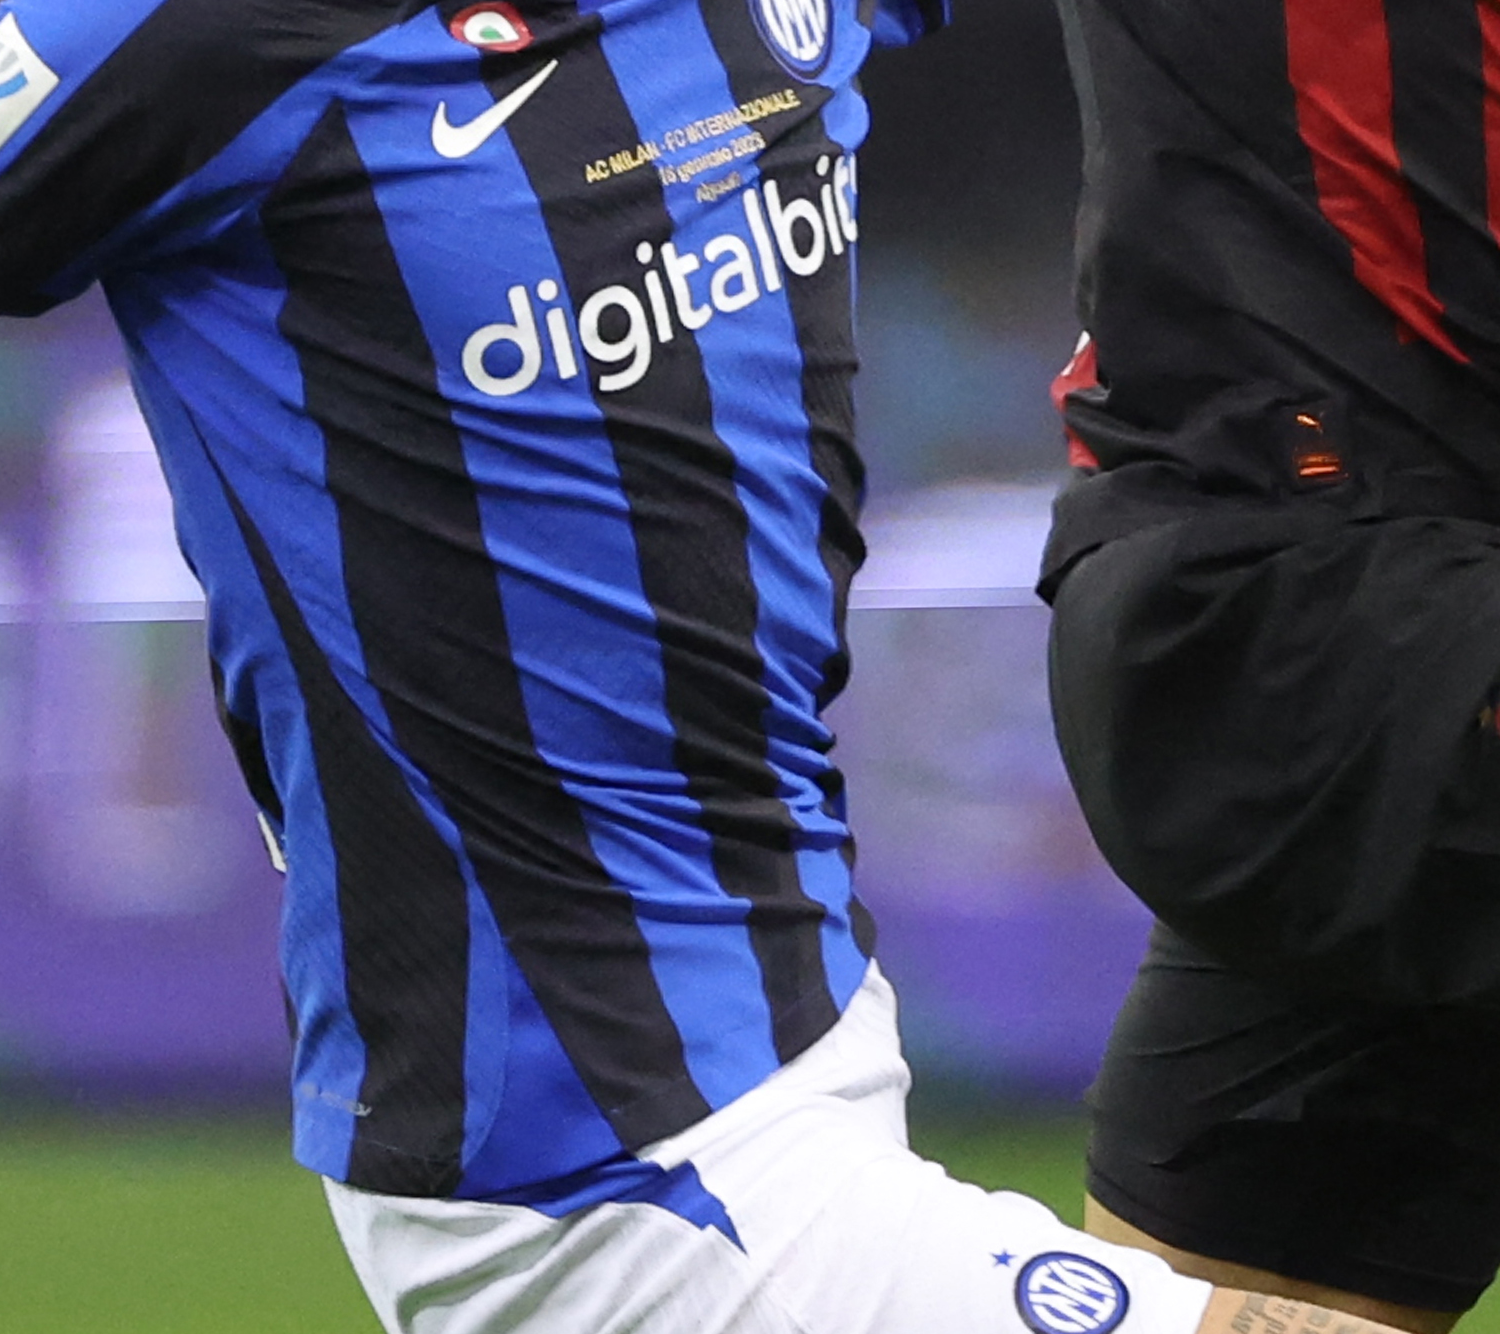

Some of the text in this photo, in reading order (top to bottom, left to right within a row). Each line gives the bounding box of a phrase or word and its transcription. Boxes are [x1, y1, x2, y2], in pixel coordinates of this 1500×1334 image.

[584, 159, 611, 183] AC
[609, 140, 661, 175] MILAN
[664, 128, 687, 153] FC
[462, 151, 858, 396] digitalbit
